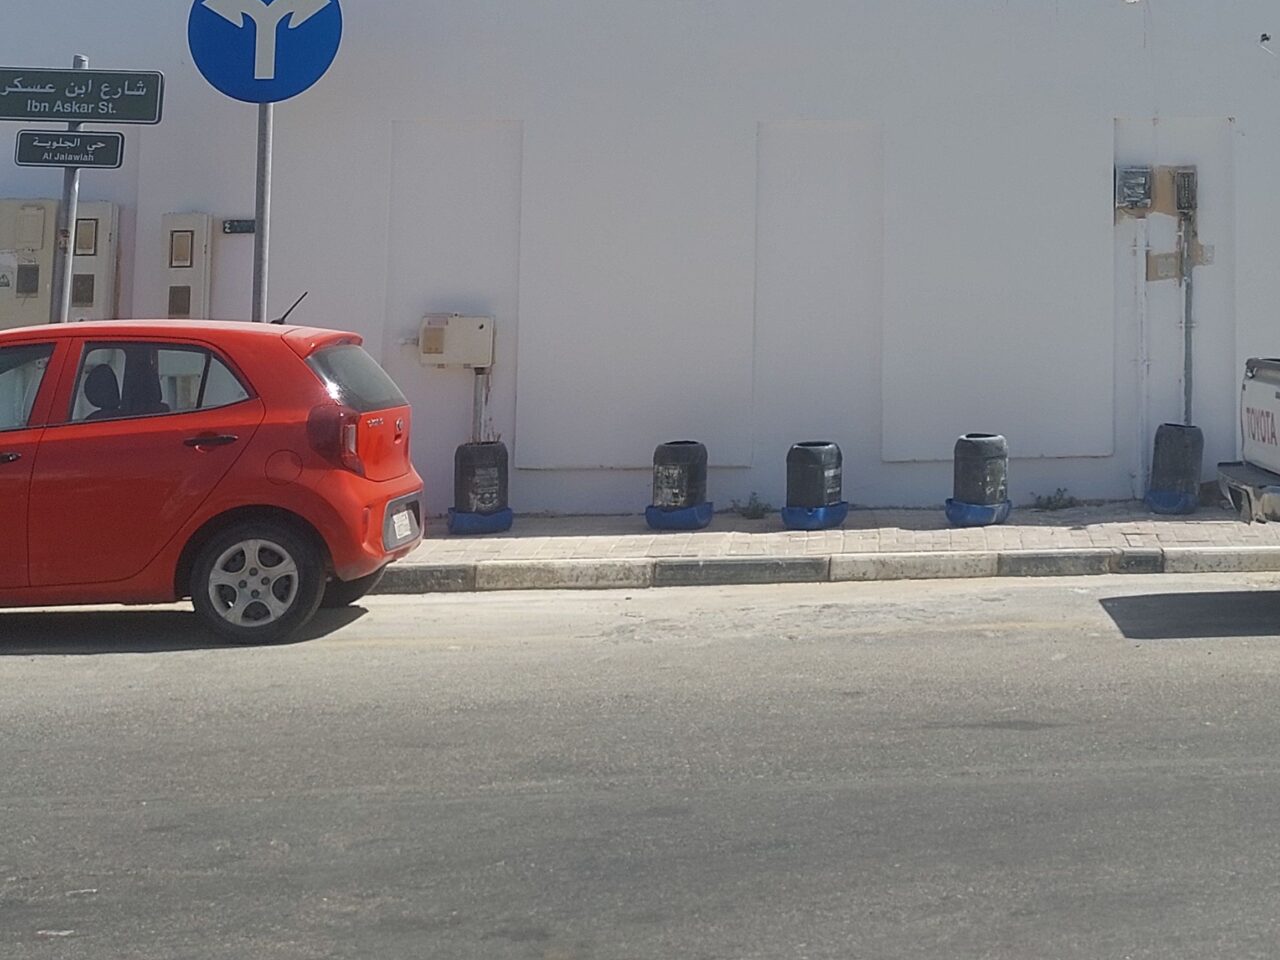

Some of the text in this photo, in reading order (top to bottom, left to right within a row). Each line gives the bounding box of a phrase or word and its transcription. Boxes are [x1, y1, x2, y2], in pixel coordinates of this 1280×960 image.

[0, 77, 147, 99] شارع ابن عسكر
[27, 99, 117, 114] Ibn Askar St.
[33, 136, 106, 153] حي الجلوية
[42, 152, 52, 160] Al
[1245, 407, 1278, 447] TOYOTA
